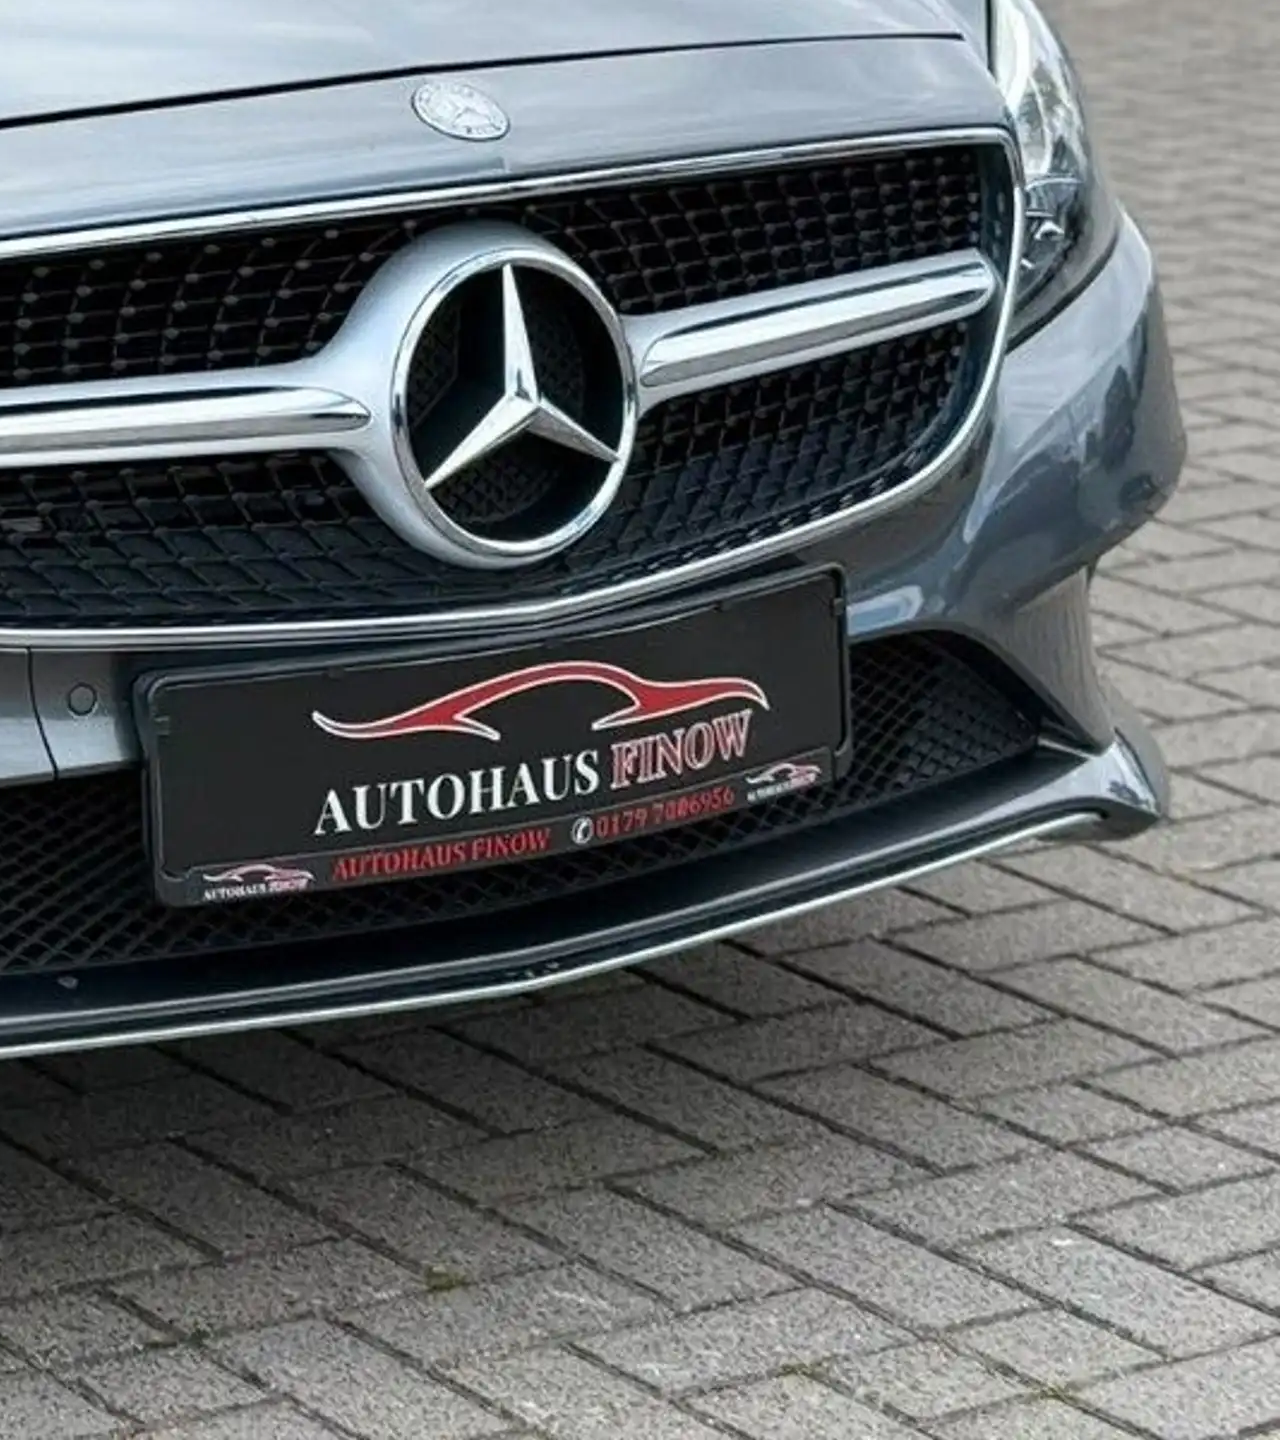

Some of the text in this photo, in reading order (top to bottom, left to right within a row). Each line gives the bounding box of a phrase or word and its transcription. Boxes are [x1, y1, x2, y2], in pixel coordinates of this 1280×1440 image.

[313, 709, 754, 836] AUTOHAUS FINOW
[332, 840, 467, 881] AUTOHAUS
[471, 826, 553, 860] FINOW
[596, 807, 648, 837] 0179
